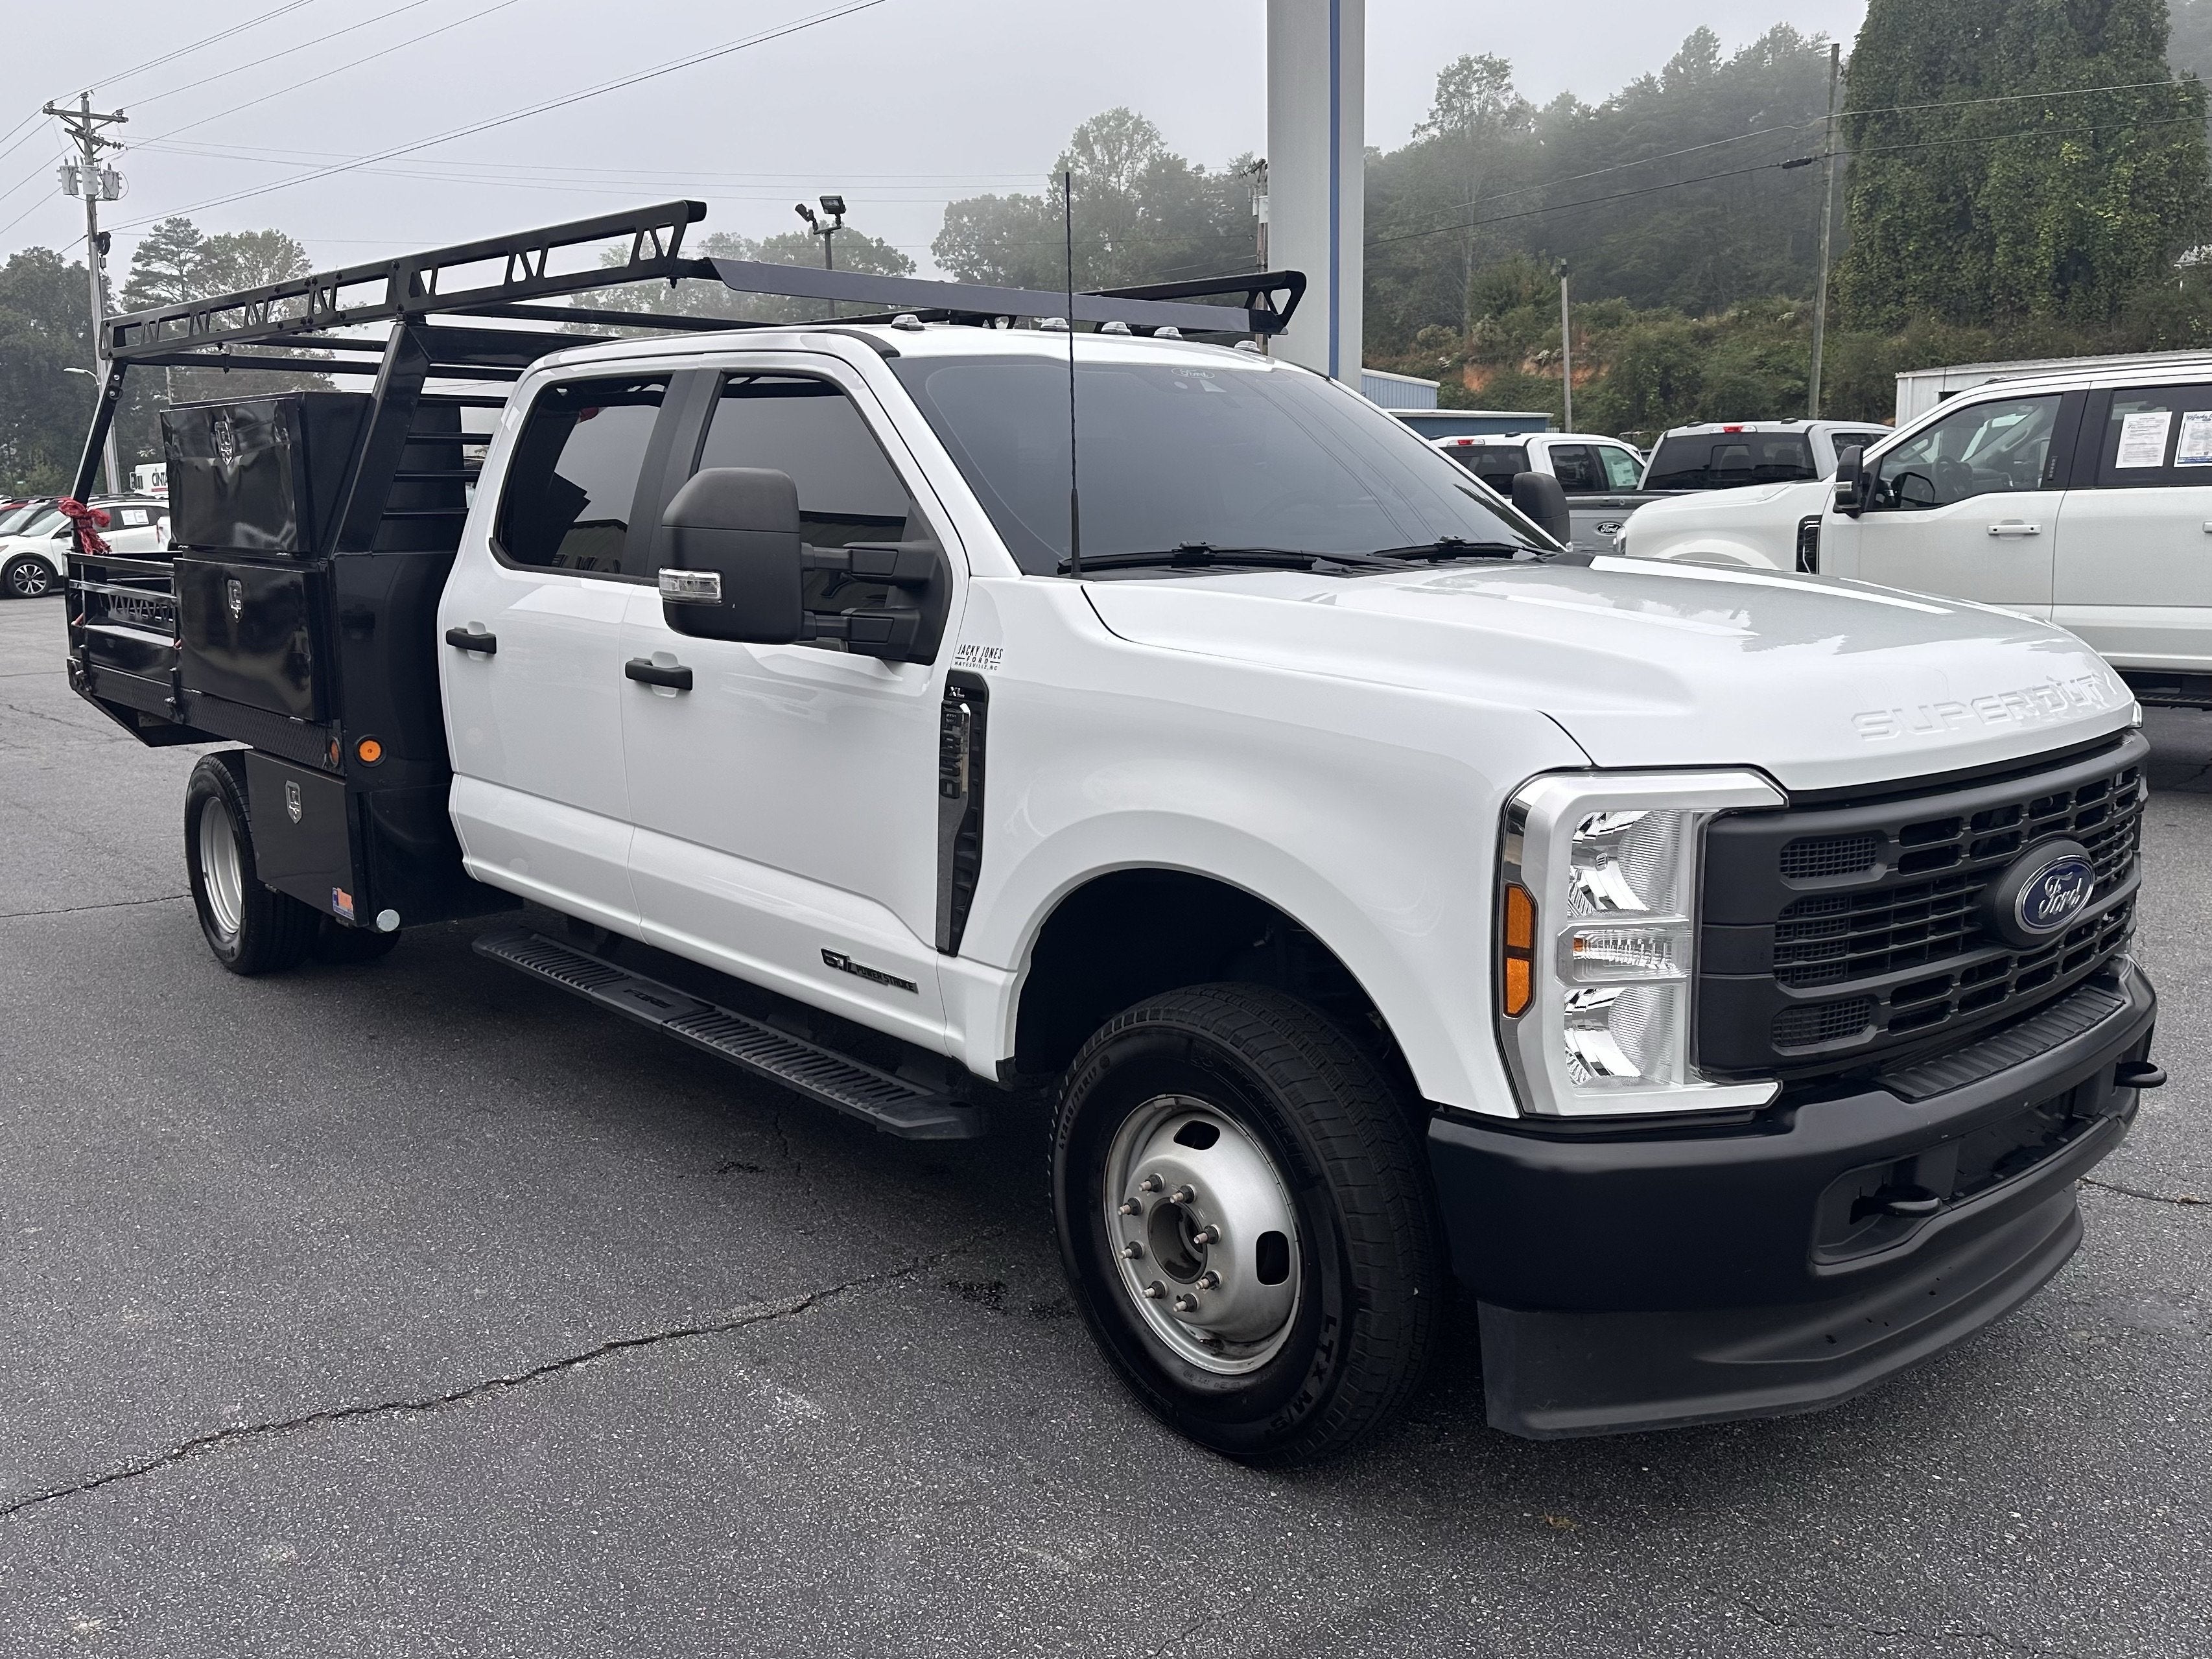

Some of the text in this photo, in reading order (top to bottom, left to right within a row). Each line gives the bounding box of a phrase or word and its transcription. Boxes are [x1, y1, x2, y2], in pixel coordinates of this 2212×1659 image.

[1179, 368, 1208, 377] Ford
[958, 644, 1003, 660] JACKY JONES
[948, 687, 965, 698] XL
[1850, 689, 2034, 742] SUPER
[2038, 871, 2082, 919] Ford
[856, 964, 884, 980] POWER
[883, 973, 915, 992] STROKE
[1312, 1314, 1337, 1383] LTX
